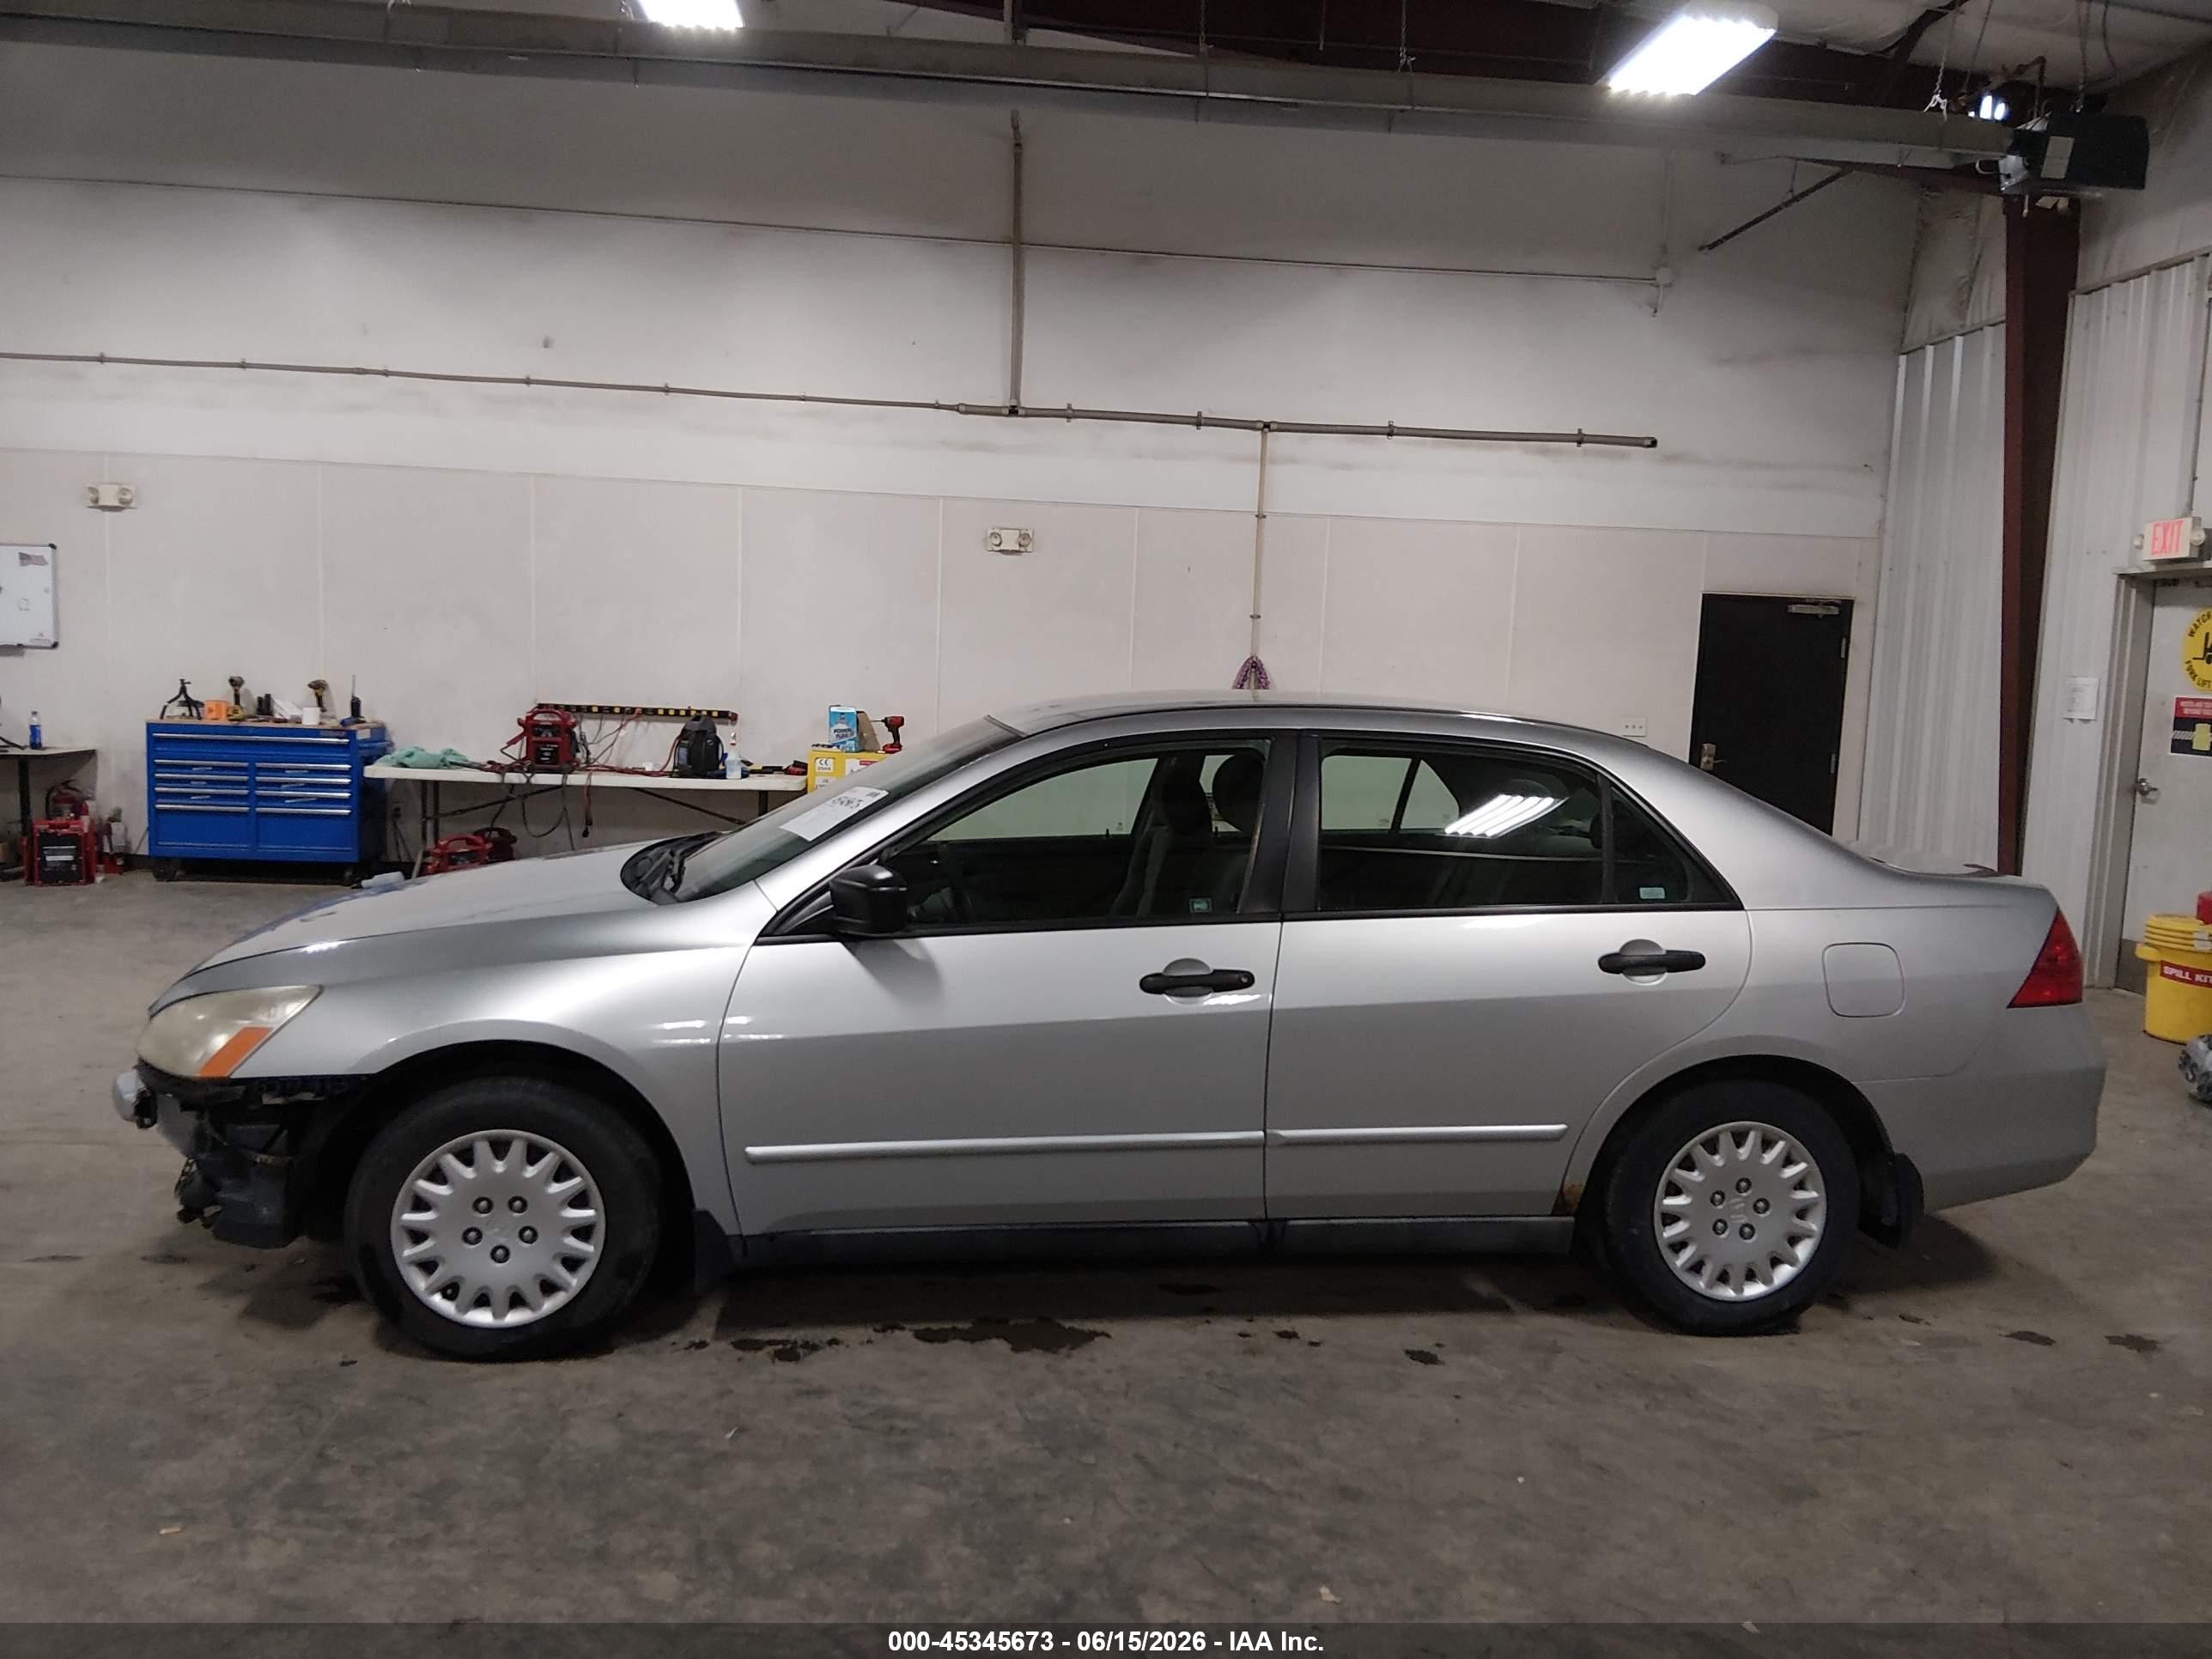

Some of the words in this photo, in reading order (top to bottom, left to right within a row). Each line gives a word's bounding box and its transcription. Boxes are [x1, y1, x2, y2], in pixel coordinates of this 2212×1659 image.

[2152, 519, 2184, 555] EXIT
[2185, 659, 2198, 682] FORK
[2163, 965, 2192, 981] SPILL
[2195, 974, 2212, 984] KIT
